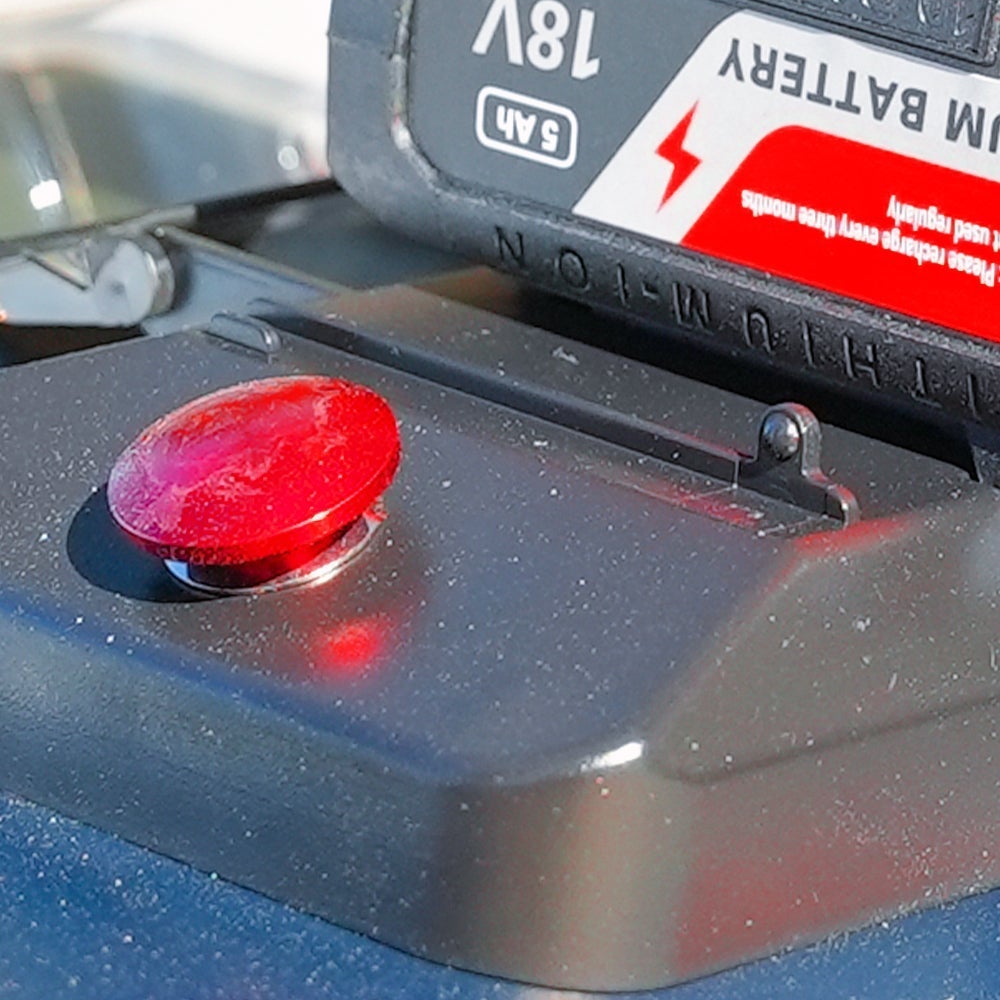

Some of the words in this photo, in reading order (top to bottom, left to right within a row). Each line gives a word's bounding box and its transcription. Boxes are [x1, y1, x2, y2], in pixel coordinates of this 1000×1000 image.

[718, 38, 928, 132] BATTERY
[741, 189, 796, 222] months
[886, 195, 952, 236] regularly
[798, 207, 836, 238] three
[837, 215, 880, 246] every
[953, 221, 990, 246] used
[882, 230, 946, 263] recharge
[948, 251, 996, 287] Please
